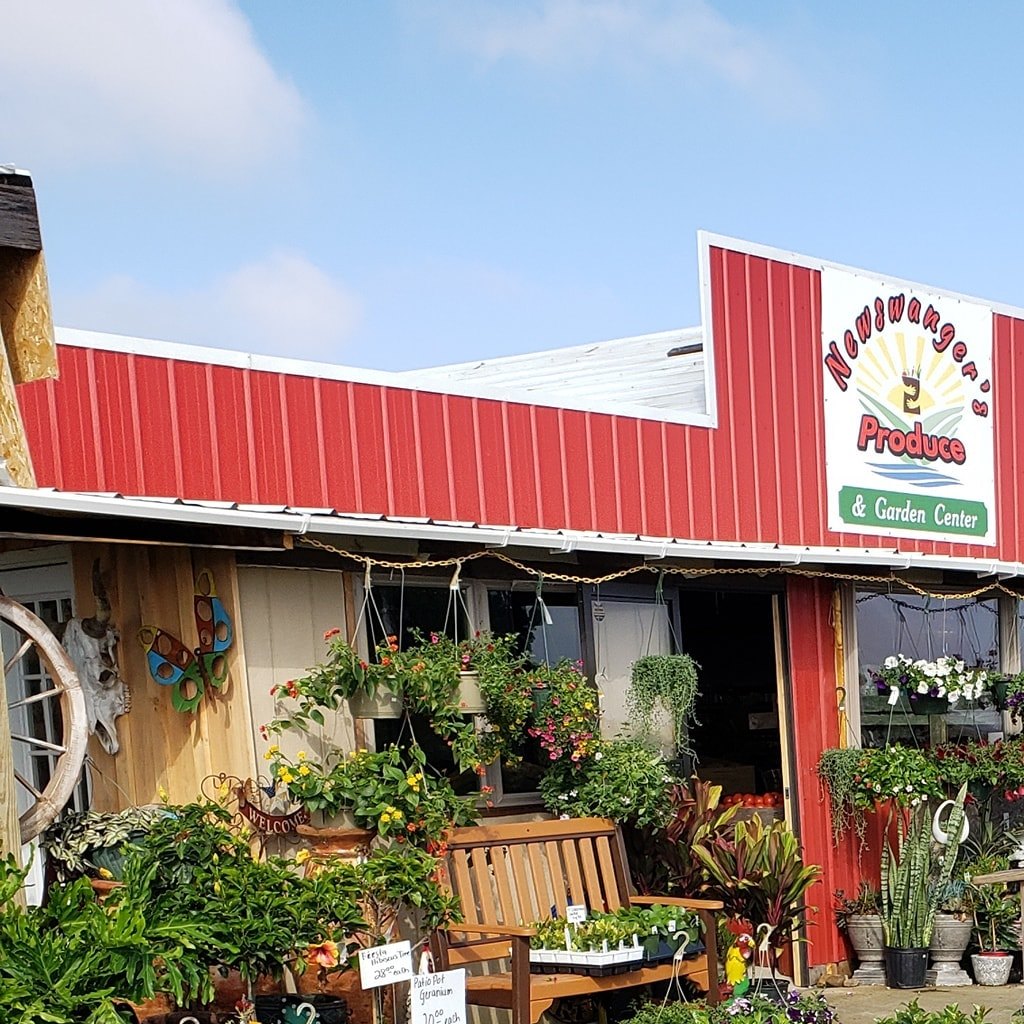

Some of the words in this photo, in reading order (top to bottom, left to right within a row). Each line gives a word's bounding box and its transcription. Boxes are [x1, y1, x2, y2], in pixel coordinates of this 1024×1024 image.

[825, 293, 990, 418] Newswanger's
[857, 414, 966, 465] Produce
[851, 494, 866, 518] &
[875, 496, 926, 524] Garden
[934, 504, 978, 529] Center
[249, 807, 305, 834] WELCOME
[413, 975, 431, 989] Patio
[433, 974, 445, 986] Pot
[420, 987, 453, 1006] Geranium
